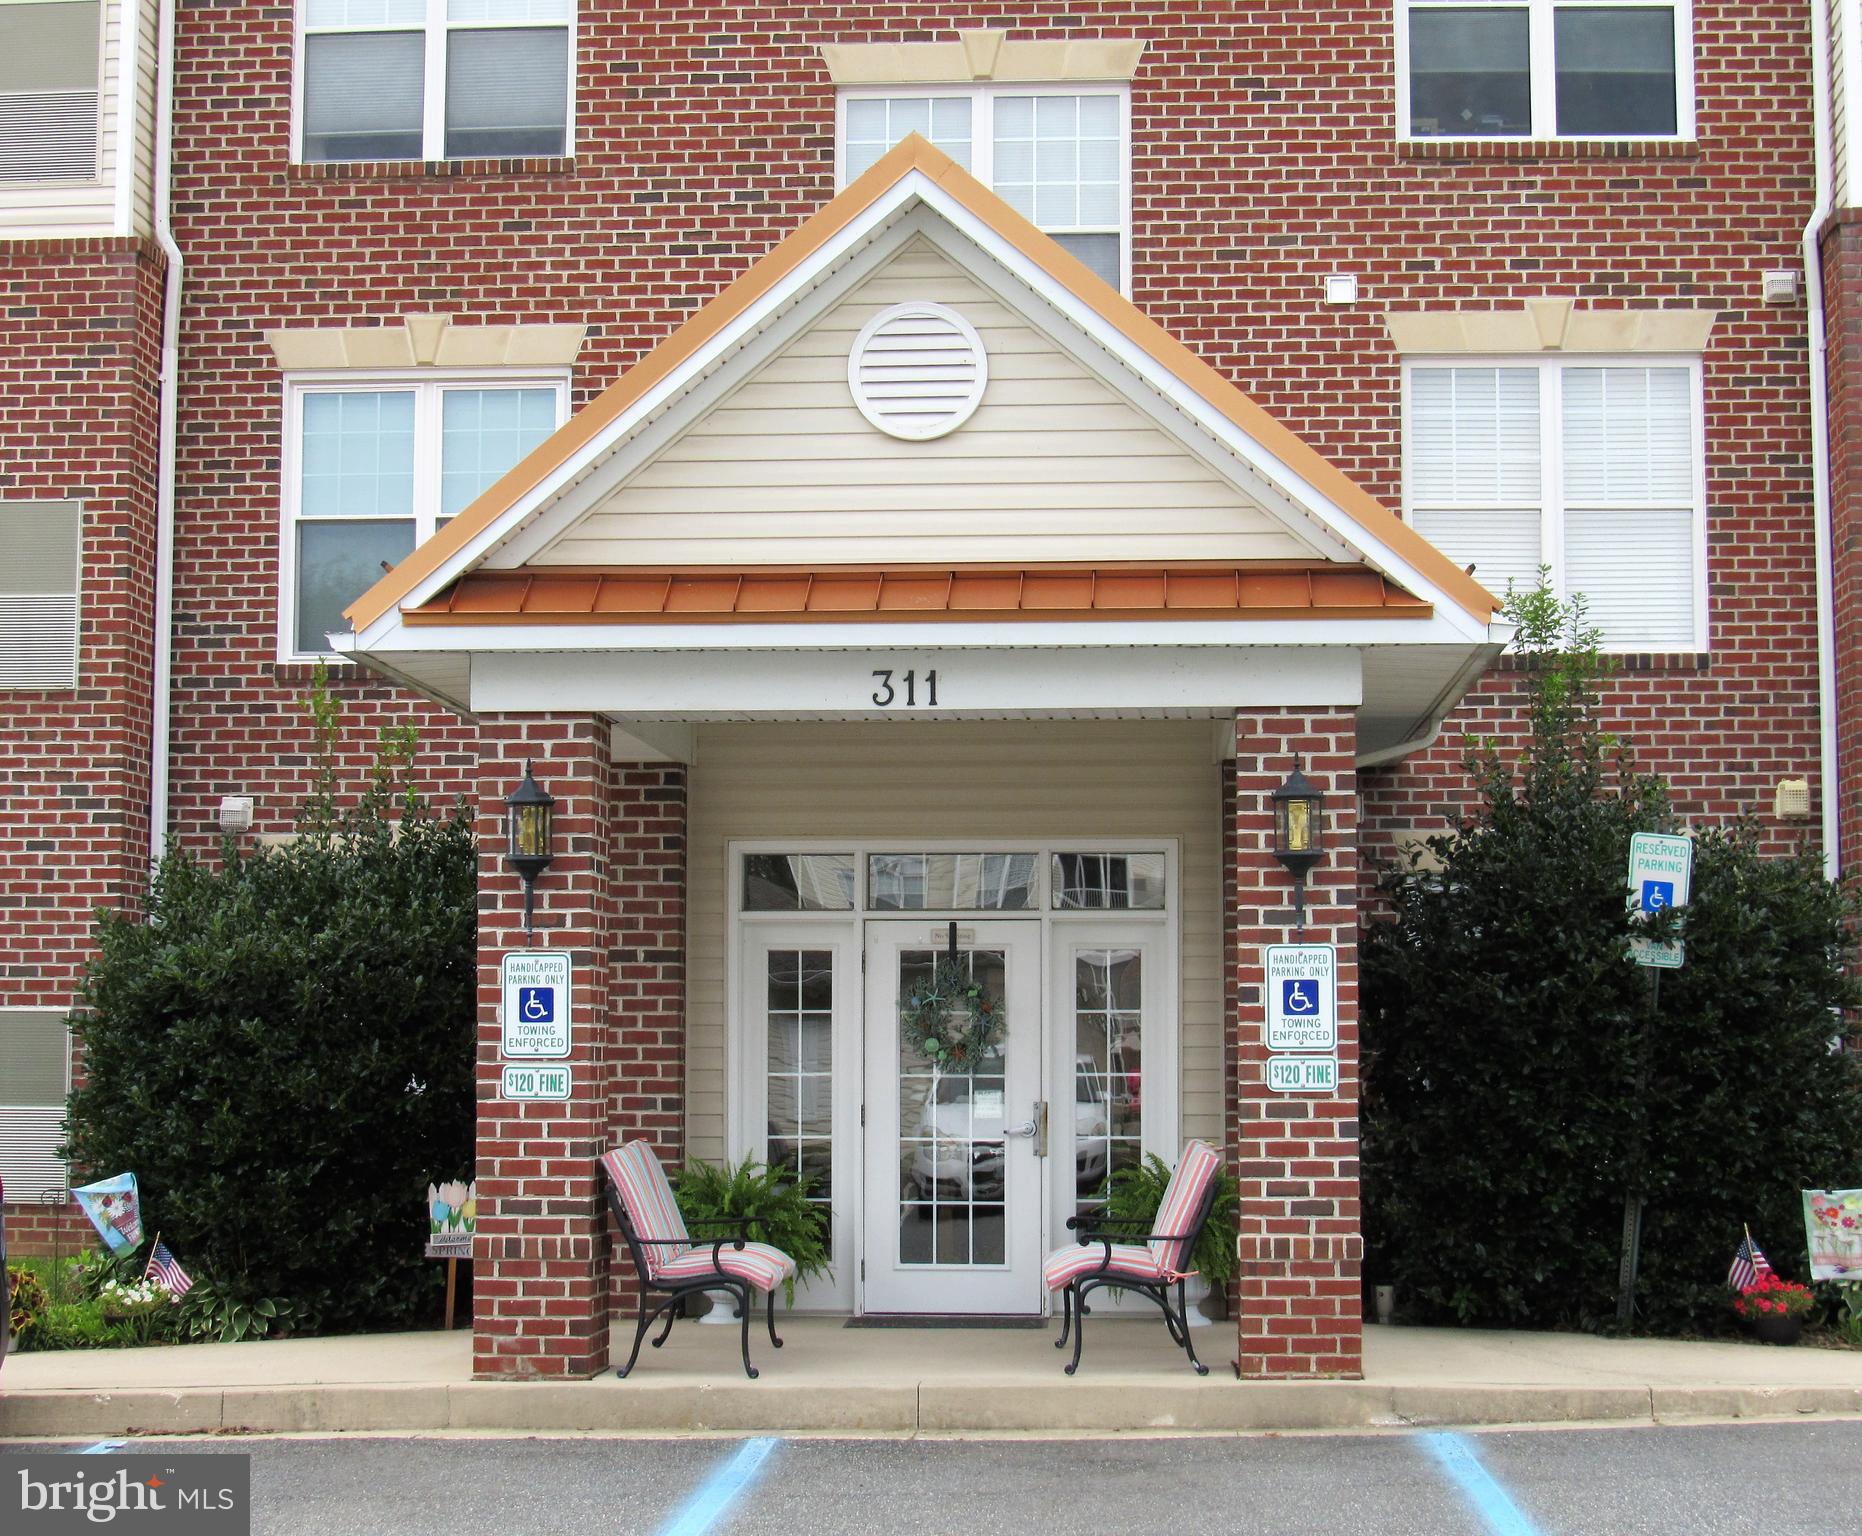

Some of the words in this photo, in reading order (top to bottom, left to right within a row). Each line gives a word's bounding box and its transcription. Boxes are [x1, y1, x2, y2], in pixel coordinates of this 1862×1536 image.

[872, 670, 938, 707] 311
[1635, 842, 1687, 858] RESERVED
[1638, 858, 1682, 873] PARKING
[1273, 954, 1328, 964] HANDICAPPED
[510, 962, 563, 973] HANDICAPPED
[1271, 967, 1305, 977] PARKING
[1310, 967, 1330, 977] ONLY
[508, 975, 541, 985] PARKING
[545, 975, 564, 985] ONLY
[1282, 1018, 1321, 1028] TOWING
[517, 1025, 556, 1036] TOWING
[1273, 1030, 1330, 1041] ENFORCED
[508, 1038, 564, 1048] ENFORCED
[1274, 1065, 1300, 1084] $120
[1306, 1065, 1331, 1084] FINE
[508, 1073, 534, 1092] $120
[539, 1074, 564, 1092] FINE
